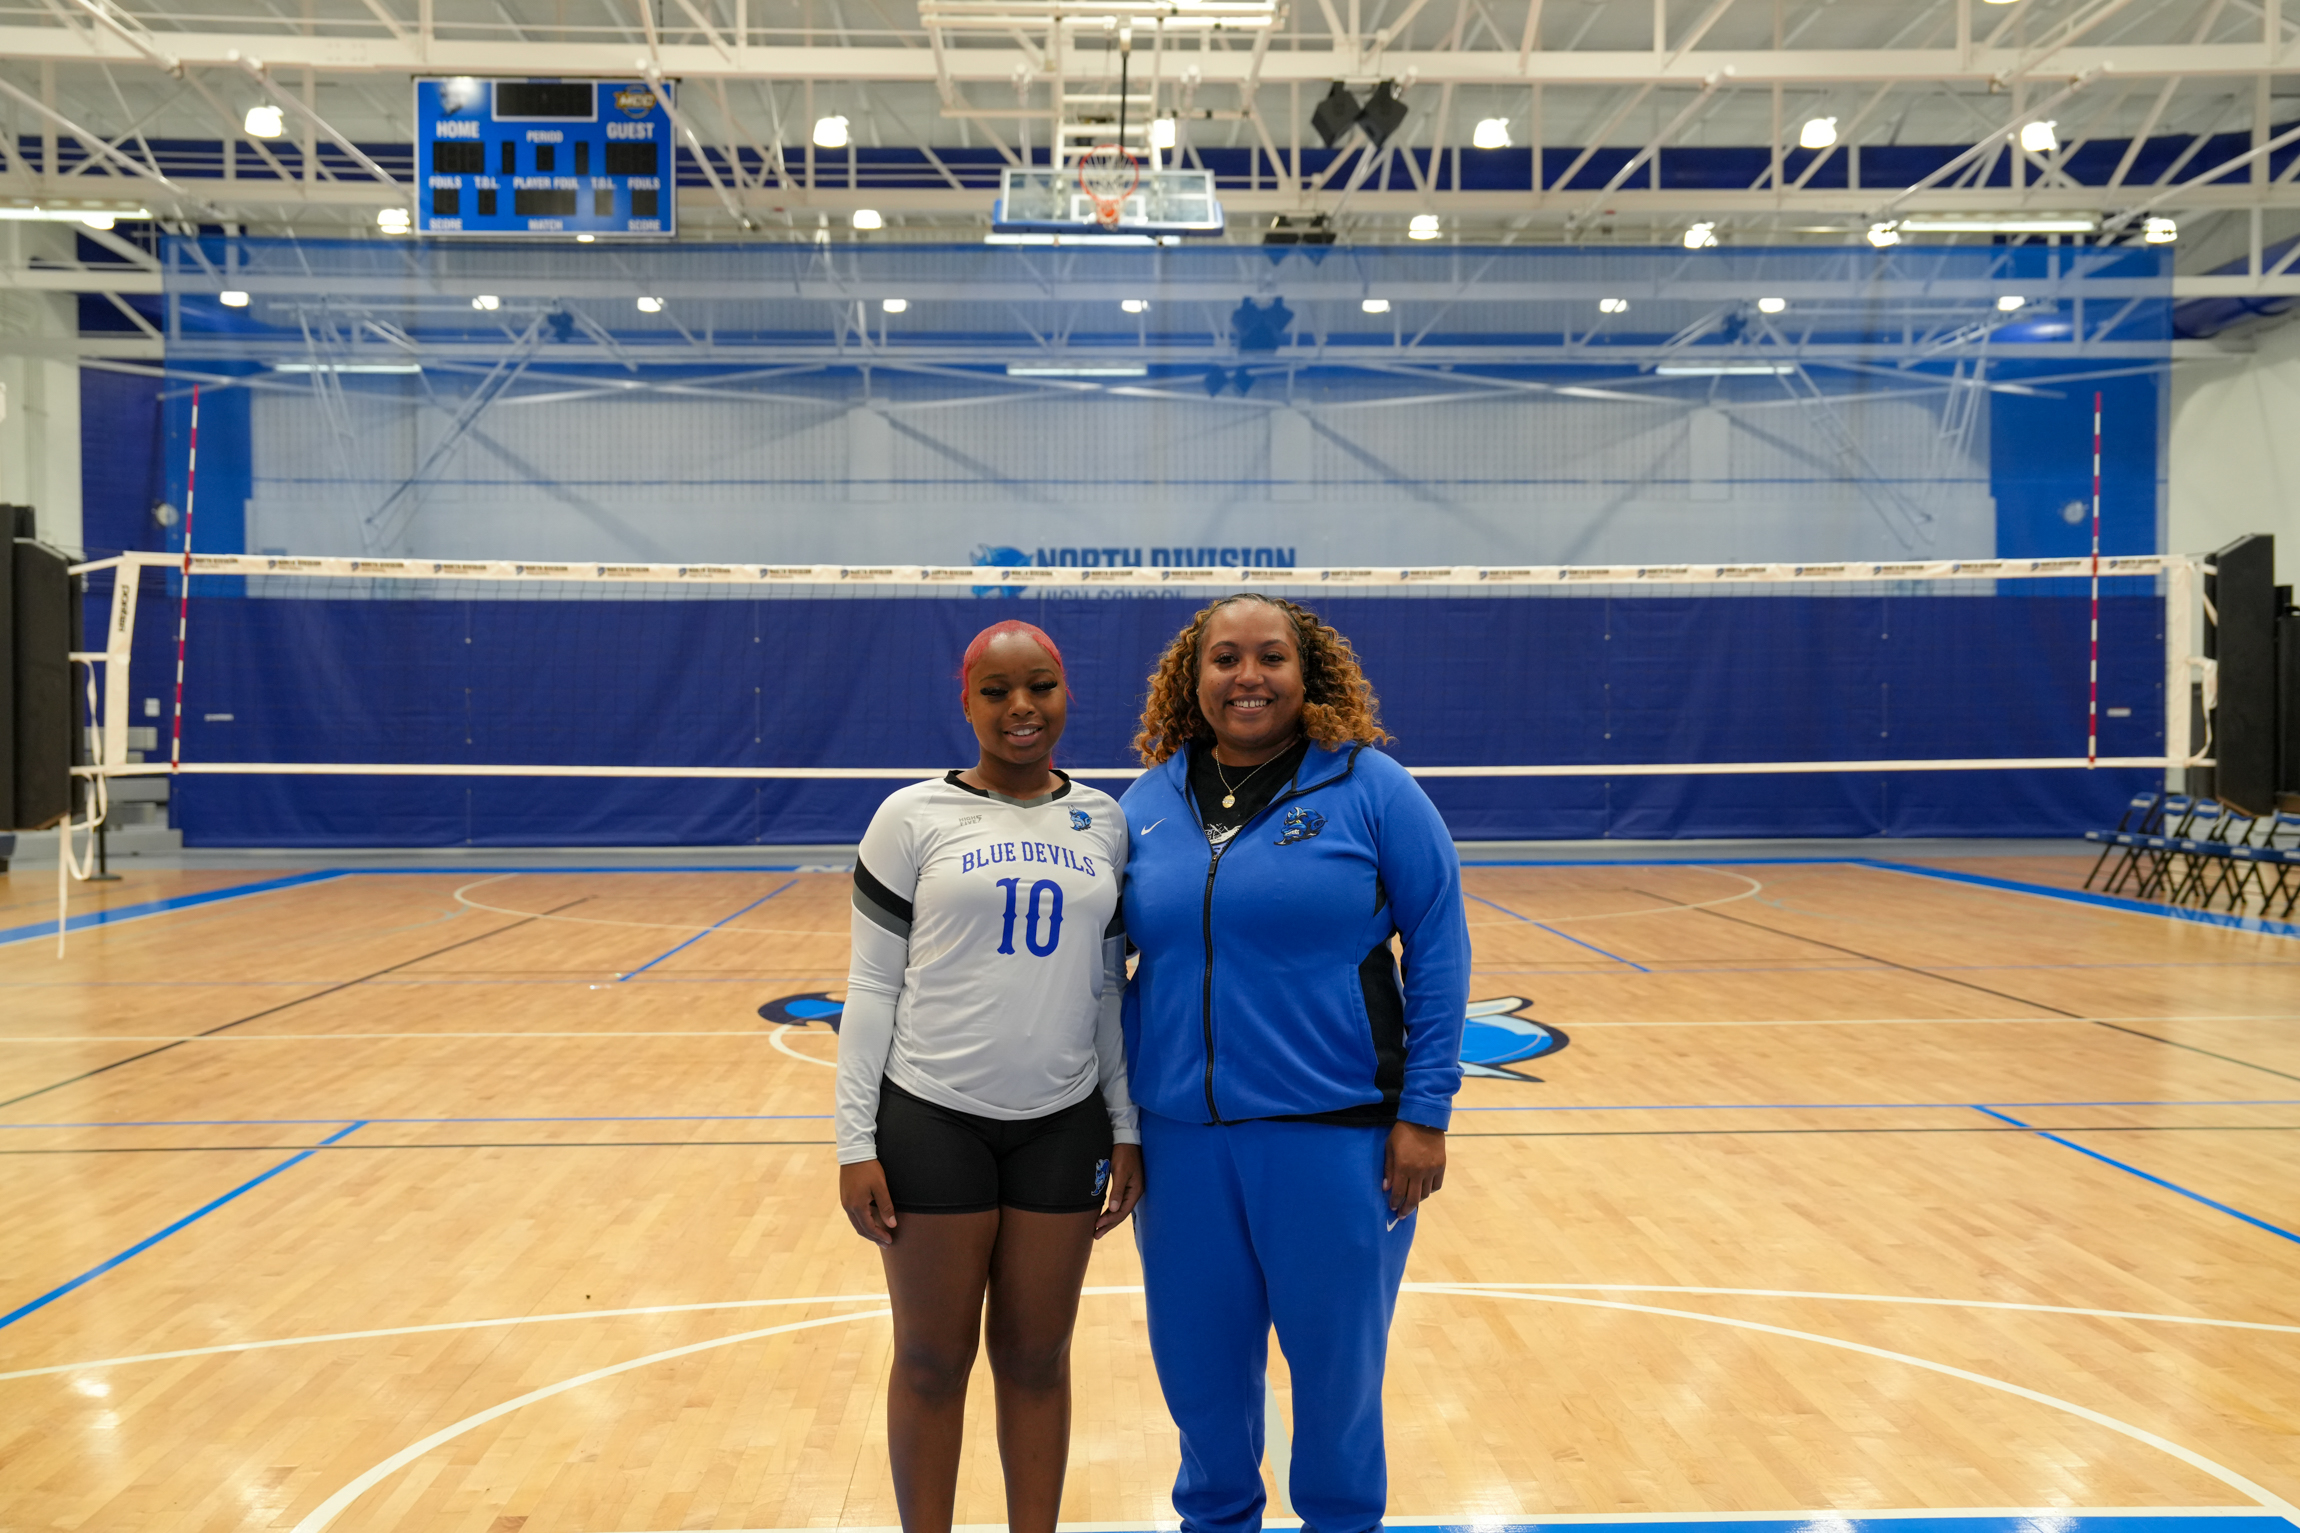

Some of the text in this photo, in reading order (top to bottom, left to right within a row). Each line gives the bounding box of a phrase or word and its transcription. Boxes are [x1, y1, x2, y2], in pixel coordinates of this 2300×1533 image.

[436, 121, 480, 138] HOME
[526, 130, 563, 142] PERIOD
[606, 122, 654, 139] GUEST
[429, 176, 462, 189] FOULS
[513, 176, 579, 190] PLAYER FOUL
[628, 178, 660, 190] FOULS
[429, 218, 462, 230] SCORE
[528, 220, 563, 231] MATCH
[628, 220, 661, 232] SCORE
[1037, 548, 1296, 567] NORTH DIVISION
[962, 842, 1096, 876] BLUE DEVILS
[996, 878, 1064, 957] 10
